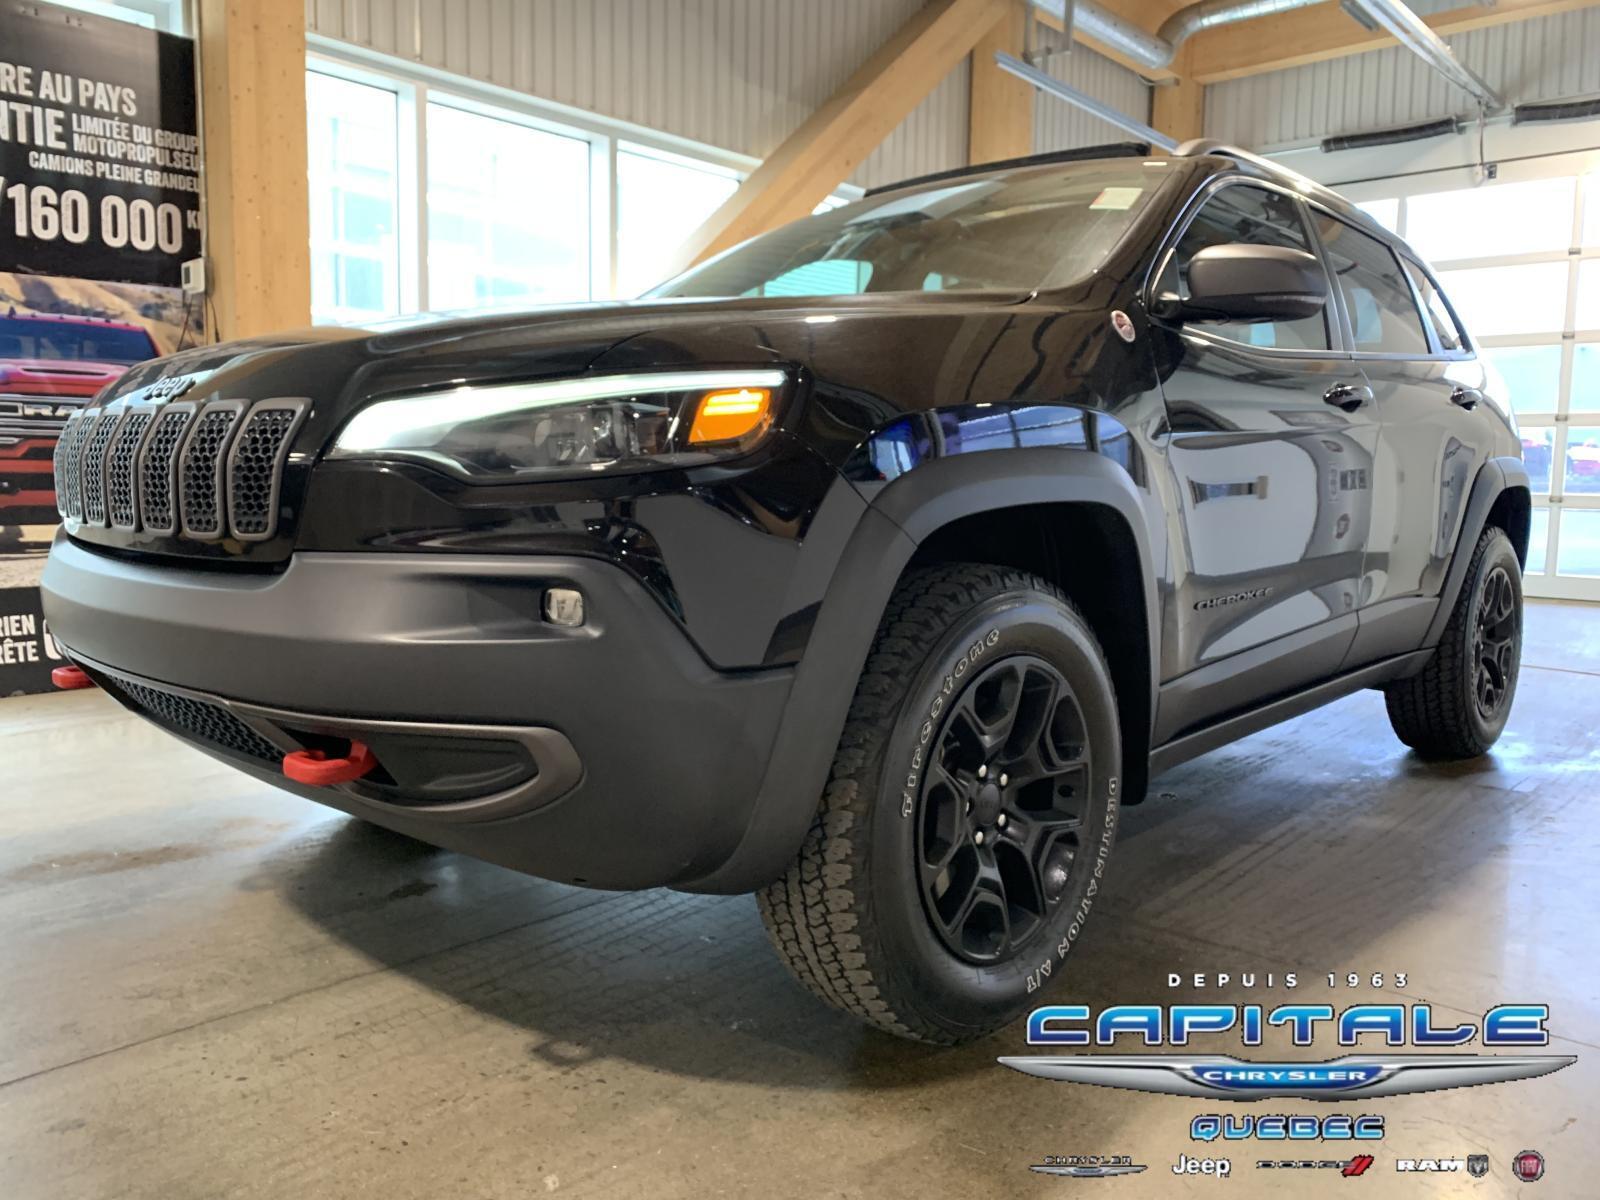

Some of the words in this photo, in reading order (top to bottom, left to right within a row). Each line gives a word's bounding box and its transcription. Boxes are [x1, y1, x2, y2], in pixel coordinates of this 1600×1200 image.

[39, 70, 72, 104] AU
[78, 77, 137, 117] PAYS
[72, 113, 130, 141] LIMITÉE
[133, 125, 152, 145] DU
[29, 151, 94, 176] CAMIONS
[96, 165, 143, 184] PLEINE
[101, 195, 182, 254] 000
[1193, 587, 1273, 611] CHEROKEE
[1058, 777, 1118, 958] DESTINATION
